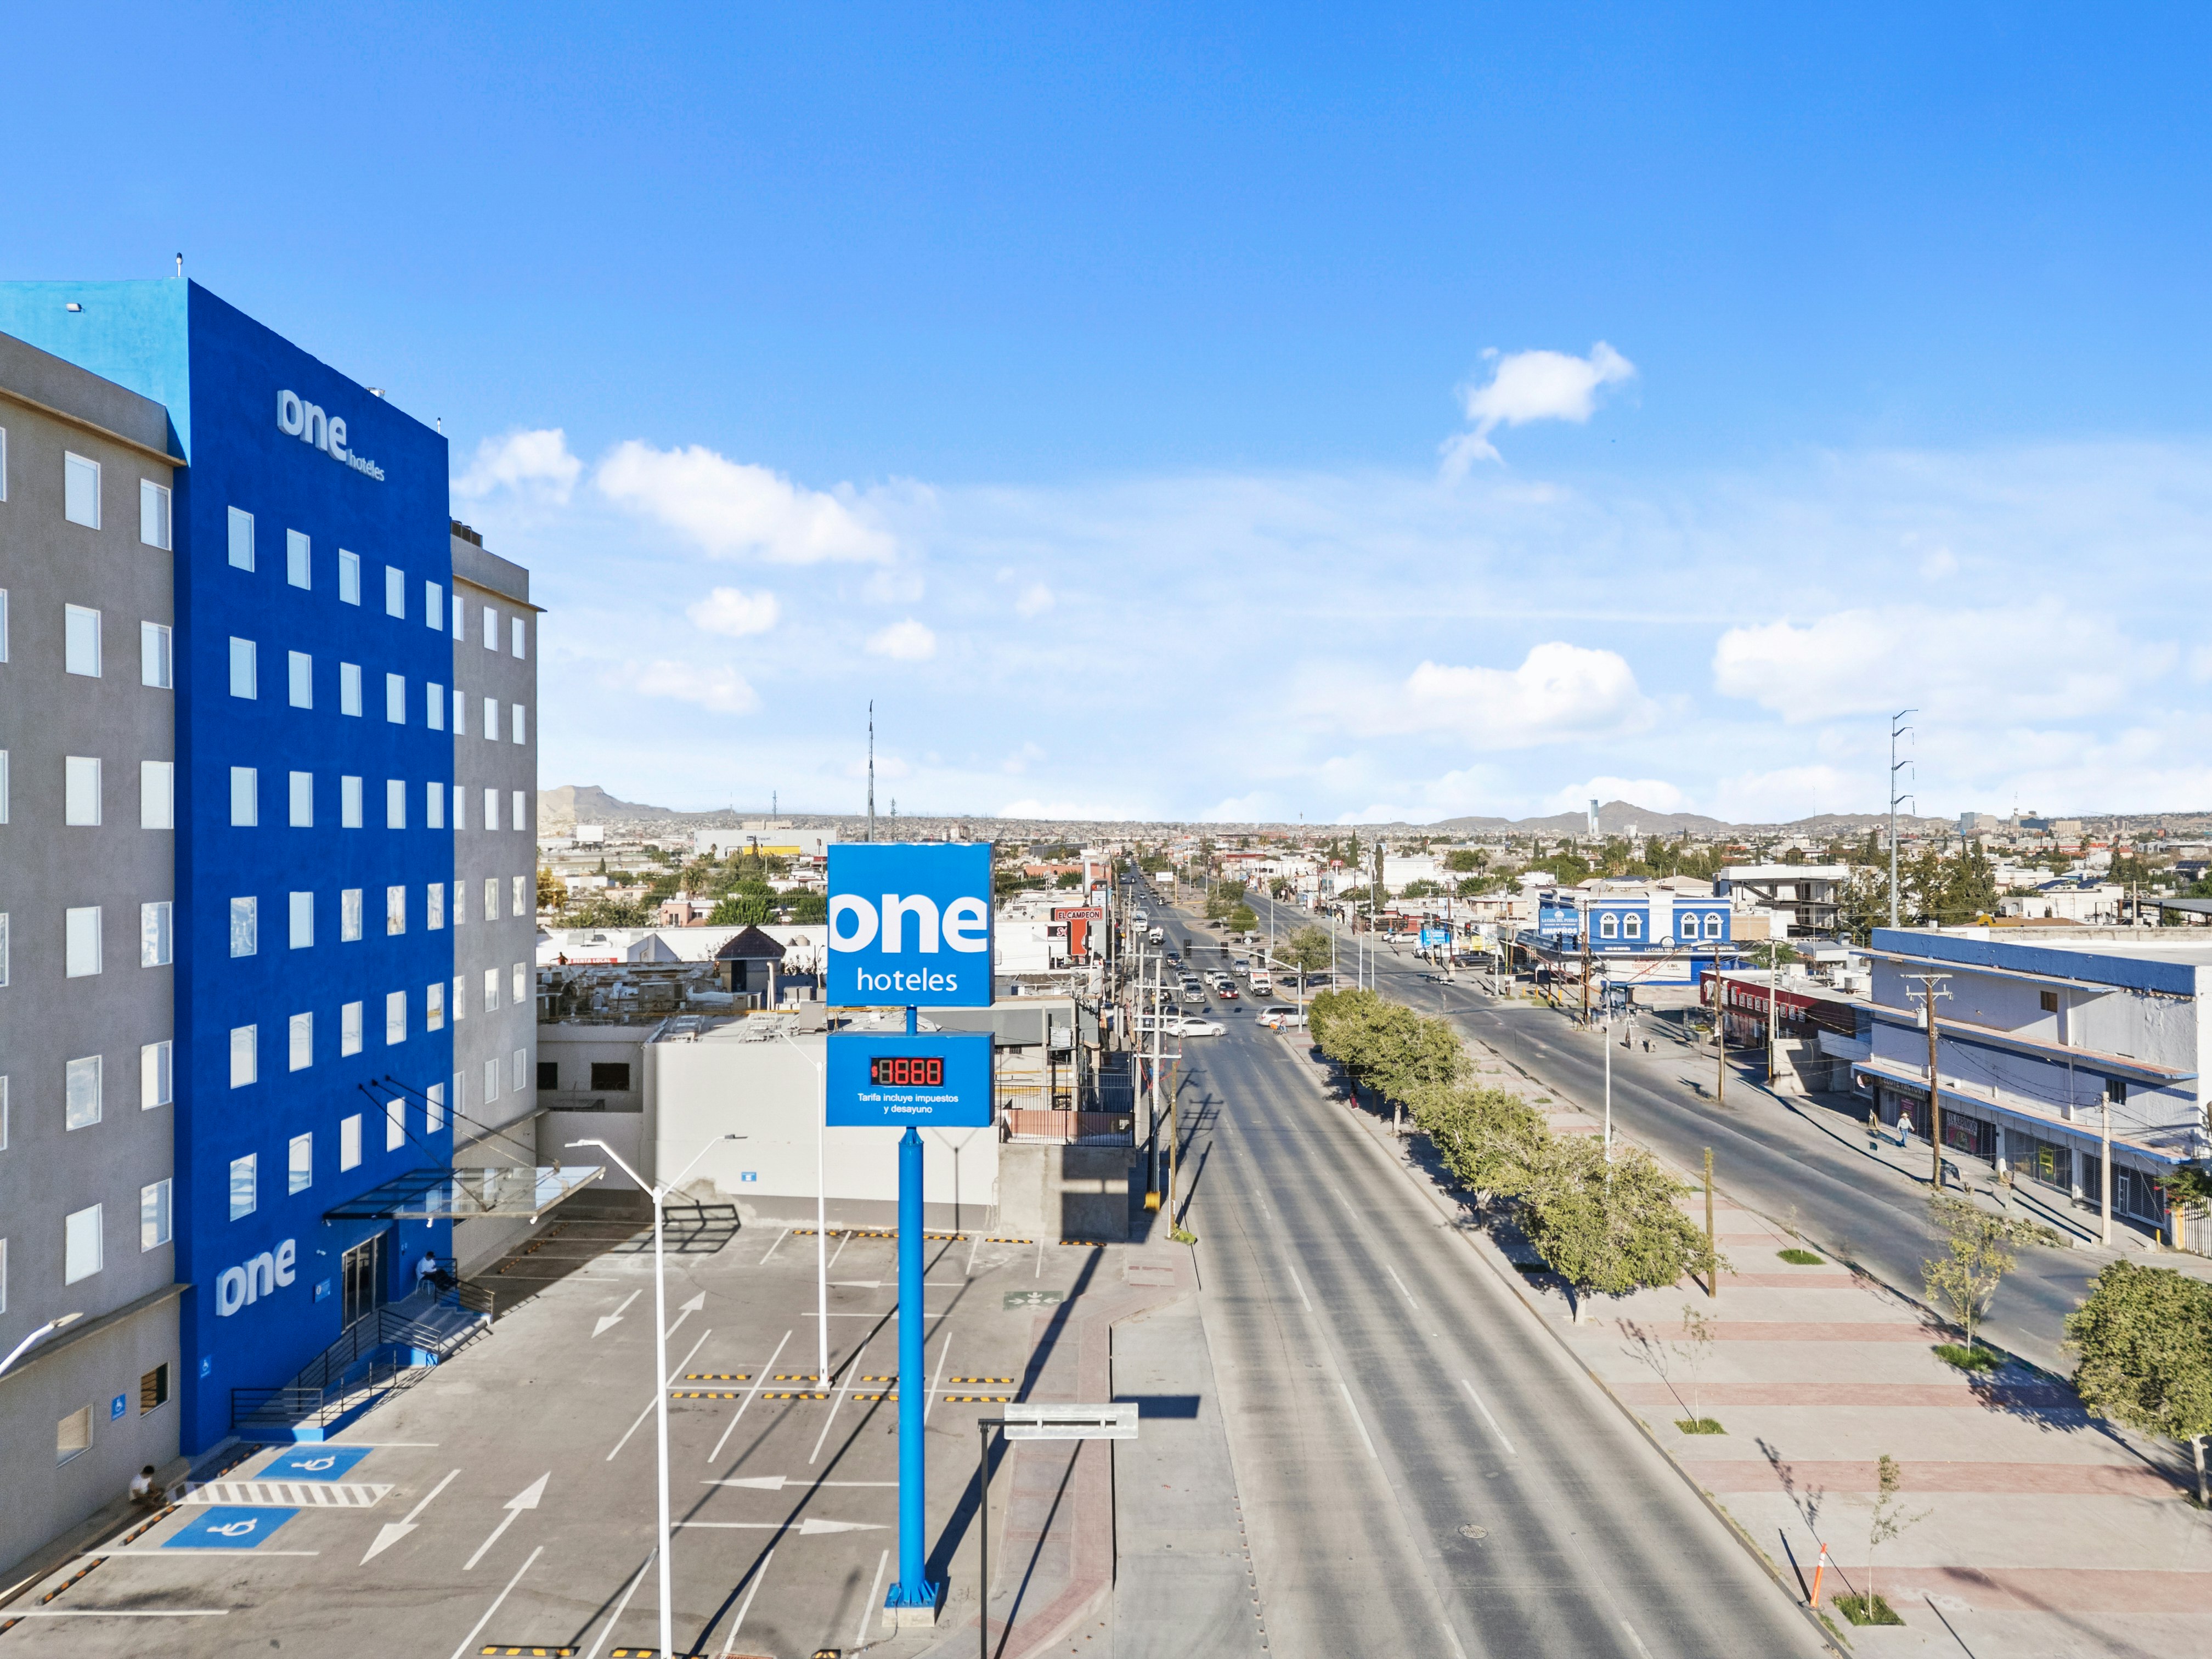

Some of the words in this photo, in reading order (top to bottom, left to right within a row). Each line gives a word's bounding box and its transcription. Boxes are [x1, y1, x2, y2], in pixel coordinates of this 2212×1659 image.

[277, 390, 347, 461] one
[346, 448, 385, 482] hoteles
[829, 894, 988, 953] one
[857, 967, 957, 992] hoteles
[857, 1093, 881, 1102] Tarifa
[883, 1093, 913, 1103] incluye
[916, 1094, 958, 1104] impuestos
[884, 1106, 889, 1114] y
[891, 1104, 933, 1114] desayuno
[216, 1239, 295, 1317] one
